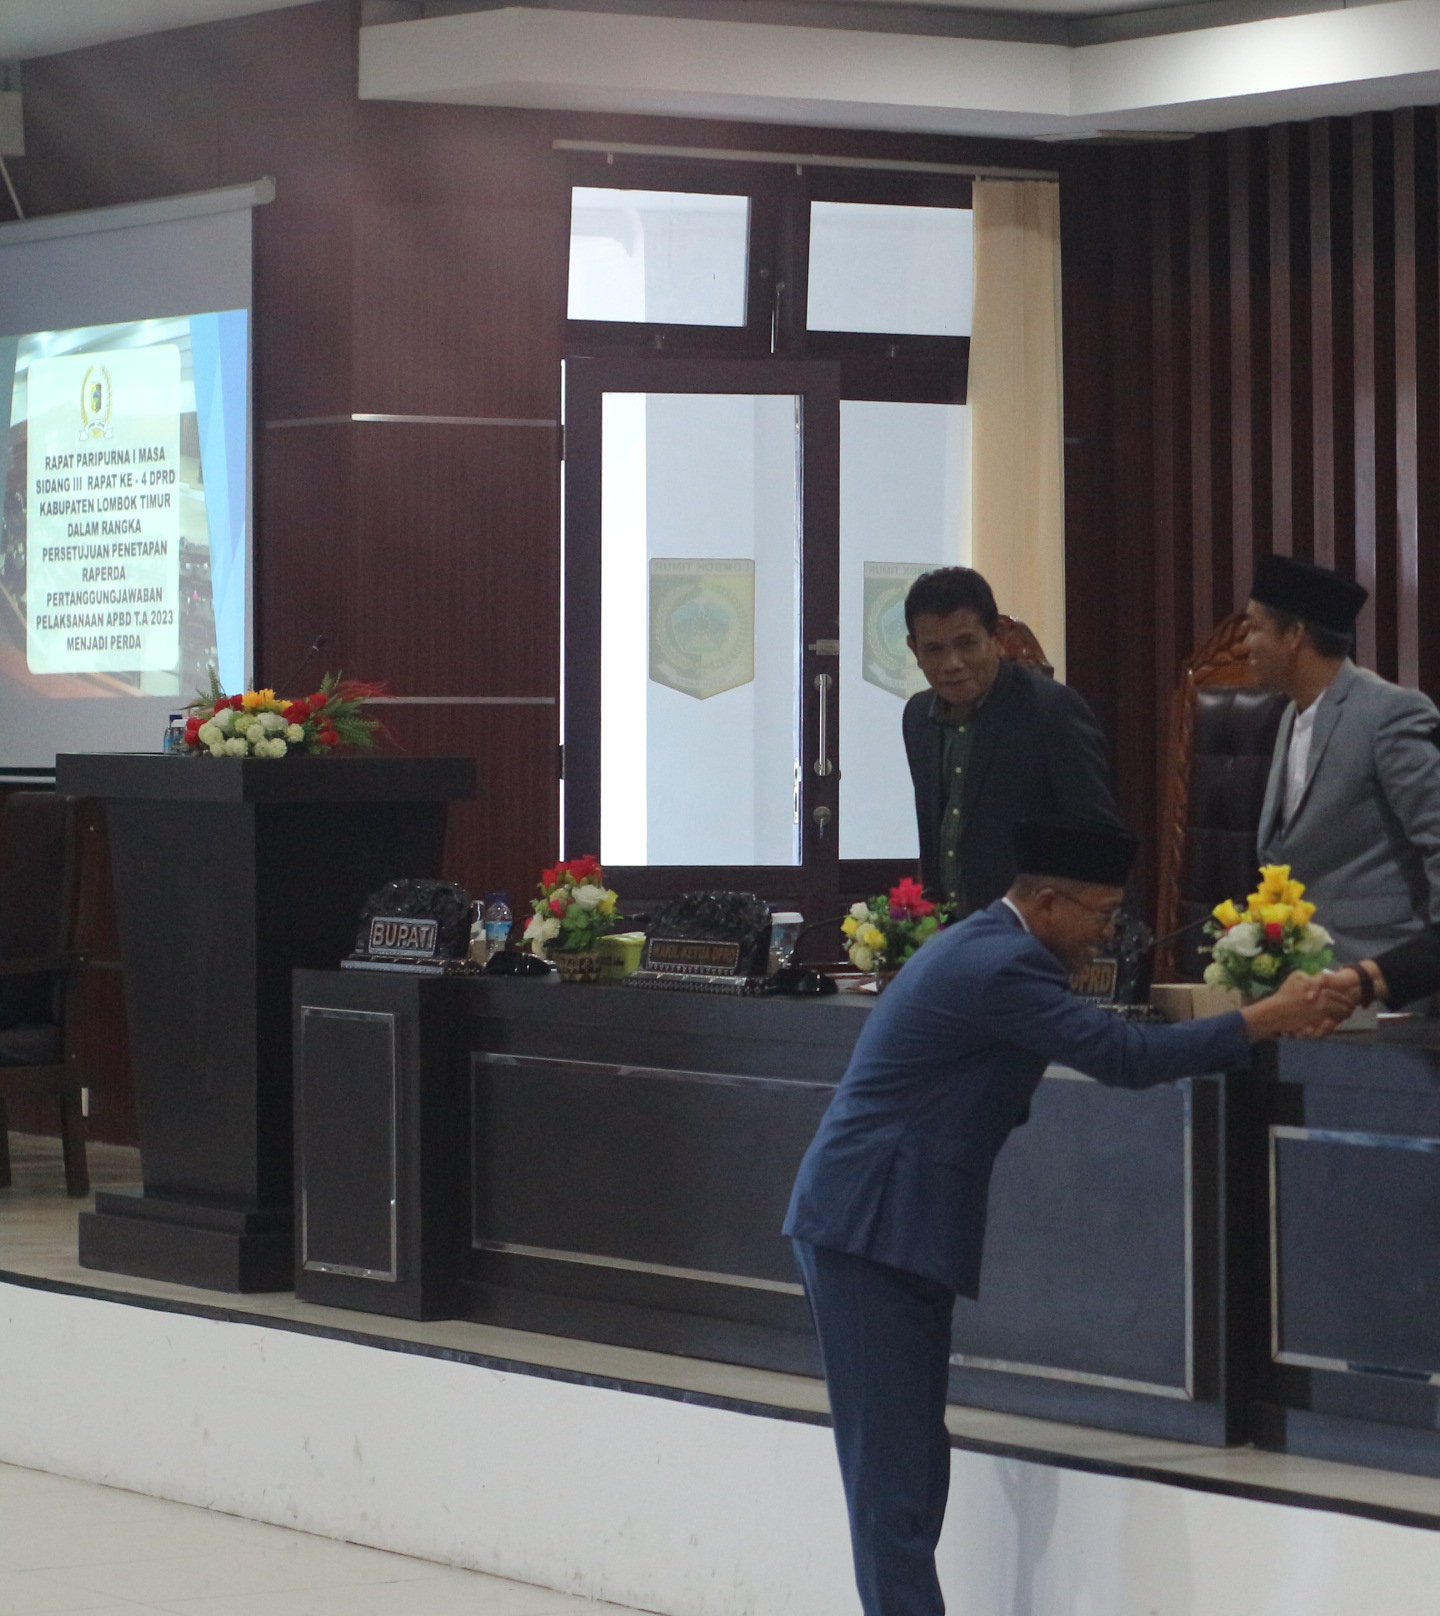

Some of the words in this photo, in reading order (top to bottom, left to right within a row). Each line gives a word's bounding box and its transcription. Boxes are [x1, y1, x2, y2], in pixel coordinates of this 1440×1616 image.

[45, 454, 74, 471] RAPAT
[76, 449, 131, 468] PARIPURNA
[132, 448, 136, 464] I
[138, 446, 166, 463] MASA
[35, 477, 70, 494] SIDANG
[73, 476, 82, 491] III
[87, 474, 117, 490] RAPAT
[119, 473, 133, 488] KE
[140, 471, 147, 487] 4
[149, 469, 176, 486] DPRD
[39, 498, 94, 517] KABUPATEN
[97, 495, 137, 512] LOMBOK
[140, 493, 171, 510] TIMUR
[67, 521, 99, 538] DALAM
[101, 518, 141, 535] RANGKA
[42, 544, 110, 563] PERSETUJUAN
[111, 540, 167, 558] PENETAPAN
[82, 565, 126, 582] RAPERDA
[46, 587, 163, 607] PERTANGGUNGJAWABAN
[36, 612, 104, 630] PELAKSANAAN
[106, 611, 131, 627] APBD
[134, 610, 148, 626] T.A
[150, 609, 174, 625] 2023
[66, 635, 108, 651] MENJADI
[110, 634, 141, 650] PERDA
[372, 922, 435, 949] BUPATI
